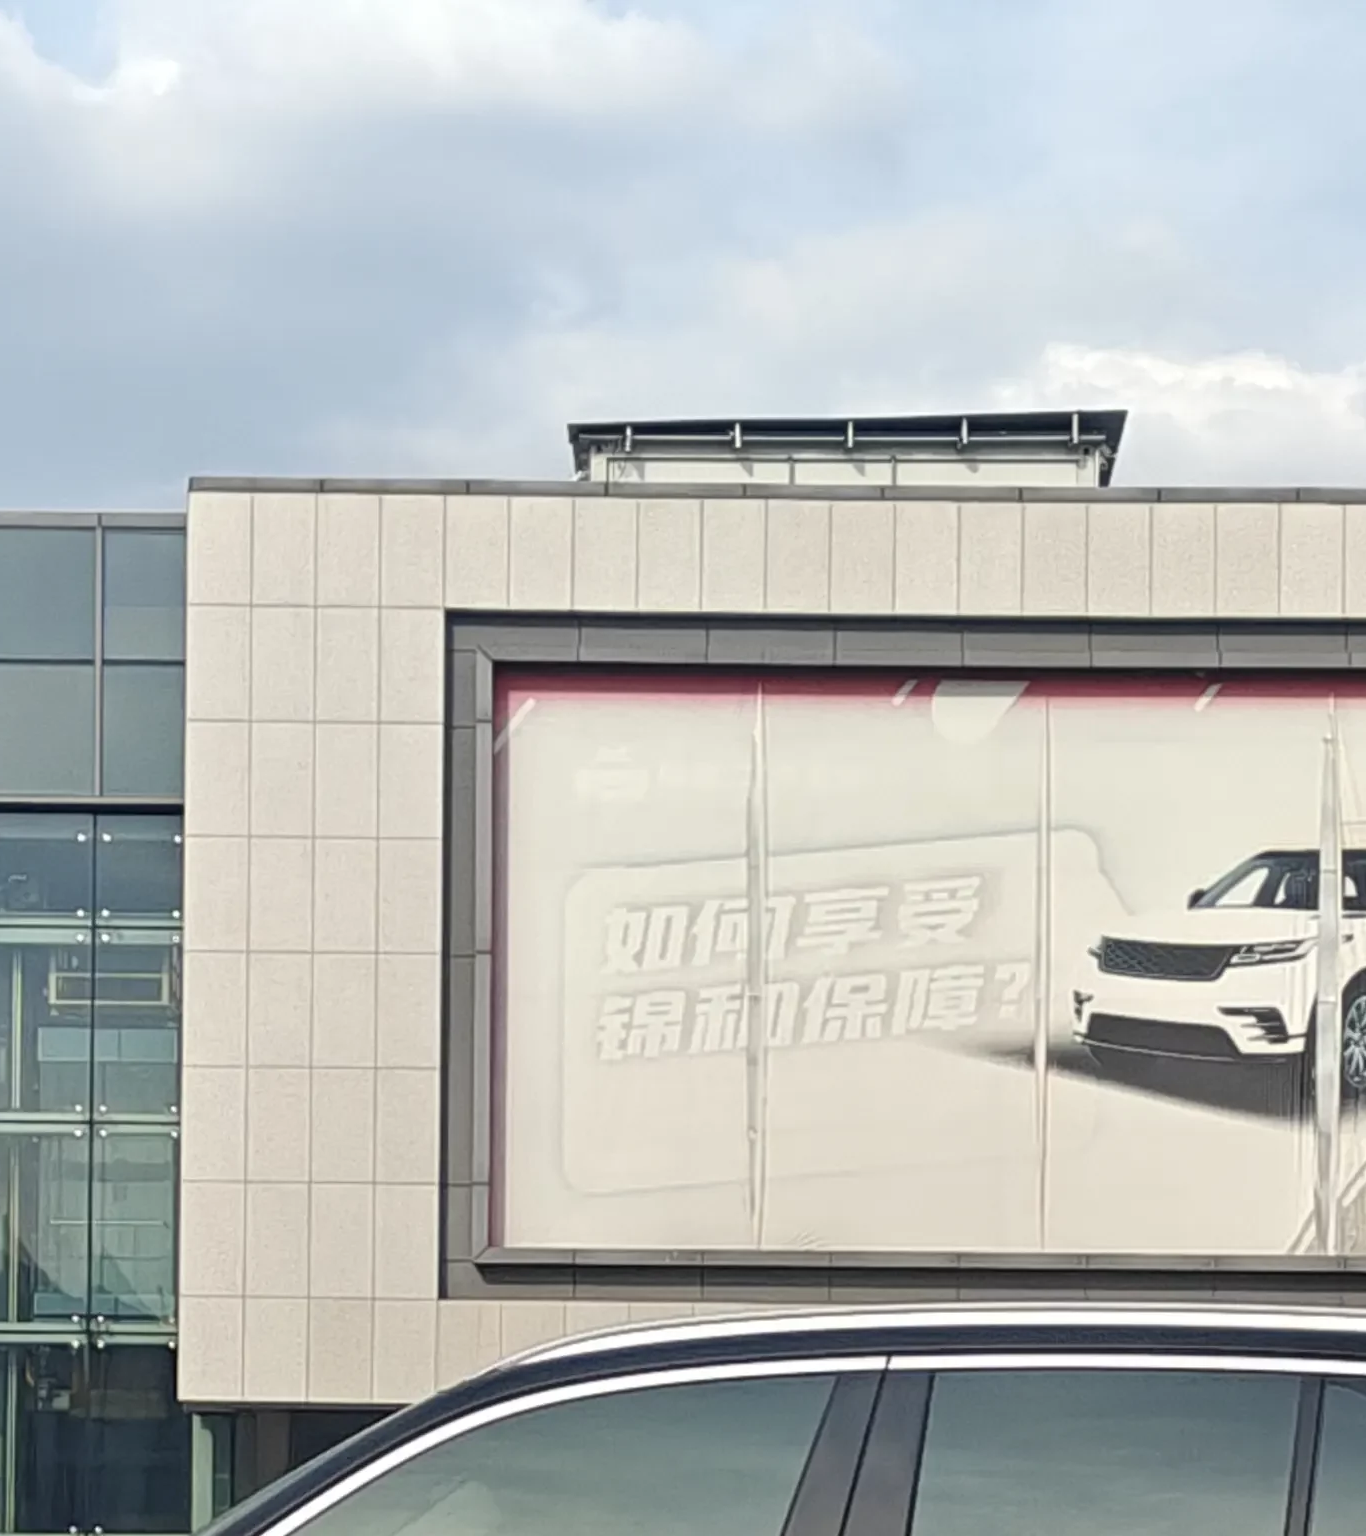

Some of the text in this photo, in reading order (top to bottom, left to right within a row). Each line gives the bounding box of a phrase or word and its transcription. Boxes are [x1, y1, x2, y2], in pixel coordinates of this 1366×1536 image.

[600, 874, 984, 975] 如何享受
[595, 961, 1031, 1060] 锦和保障？
